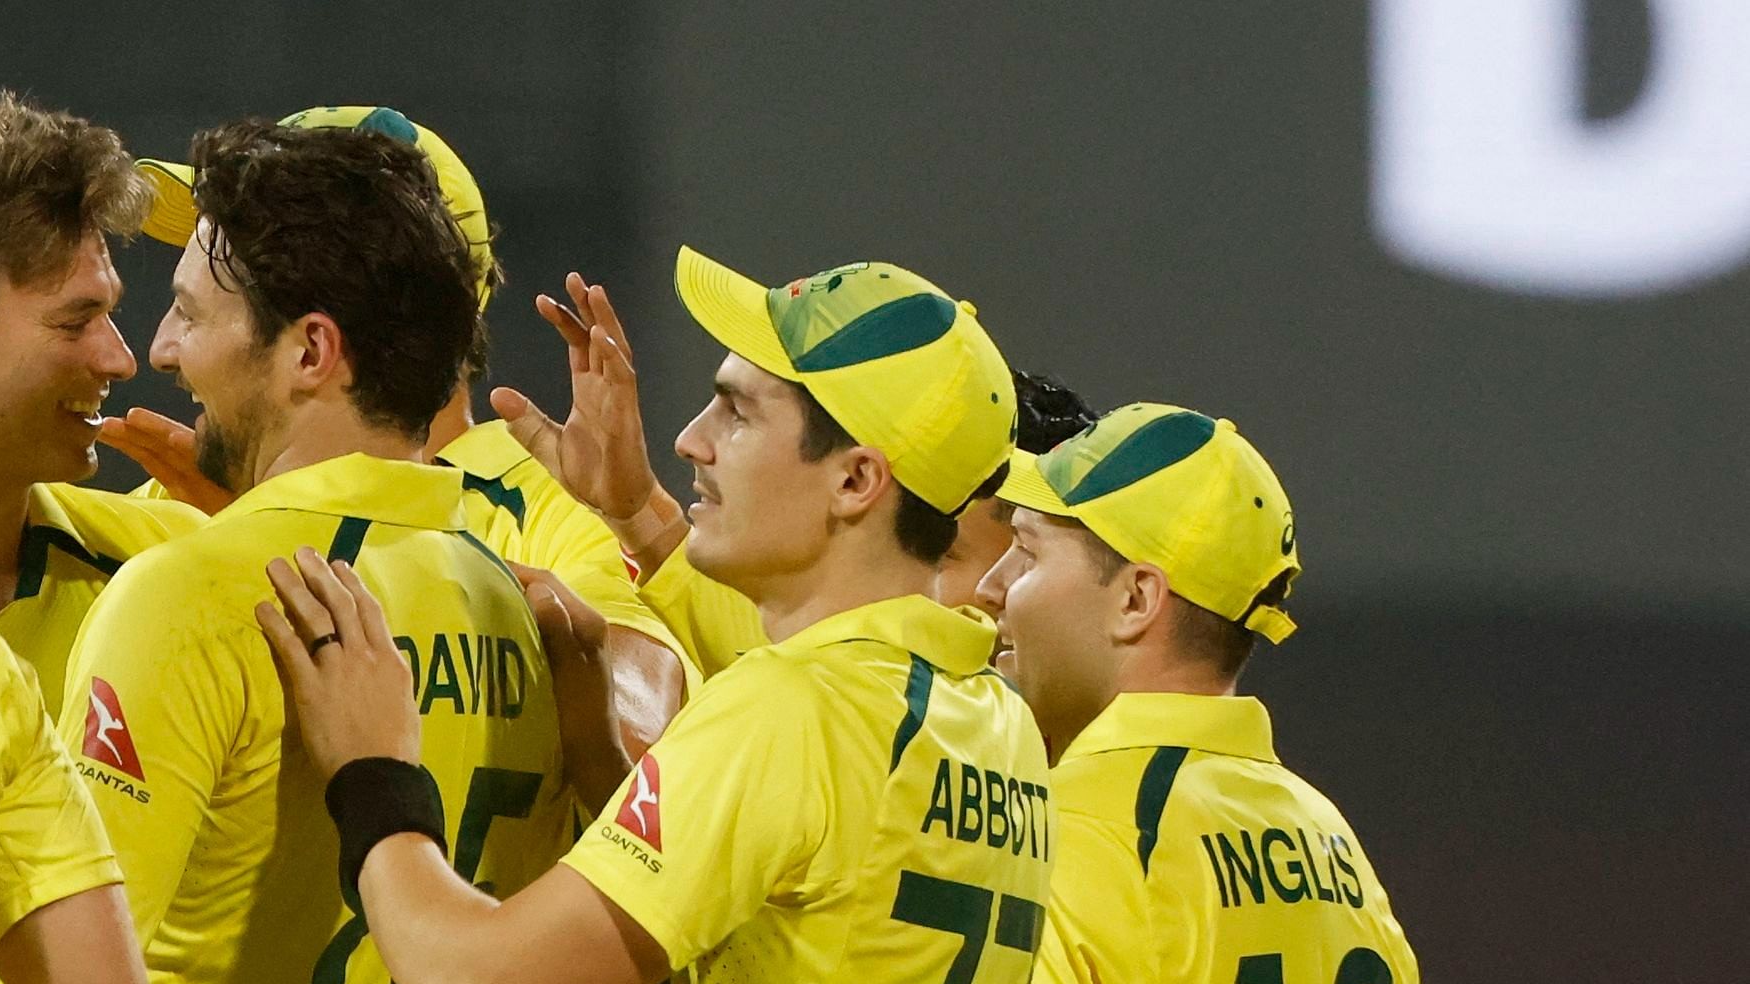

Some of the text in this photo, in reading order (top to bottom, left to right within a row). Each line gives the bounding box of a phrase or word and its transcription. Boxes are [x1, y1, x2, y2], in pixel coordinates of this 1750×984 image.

[601, 826, 663, 874] QANTAS
[920, 758, 1048, 863] ABBOTT
[1201, 828, 1364, 908] INGLIS
